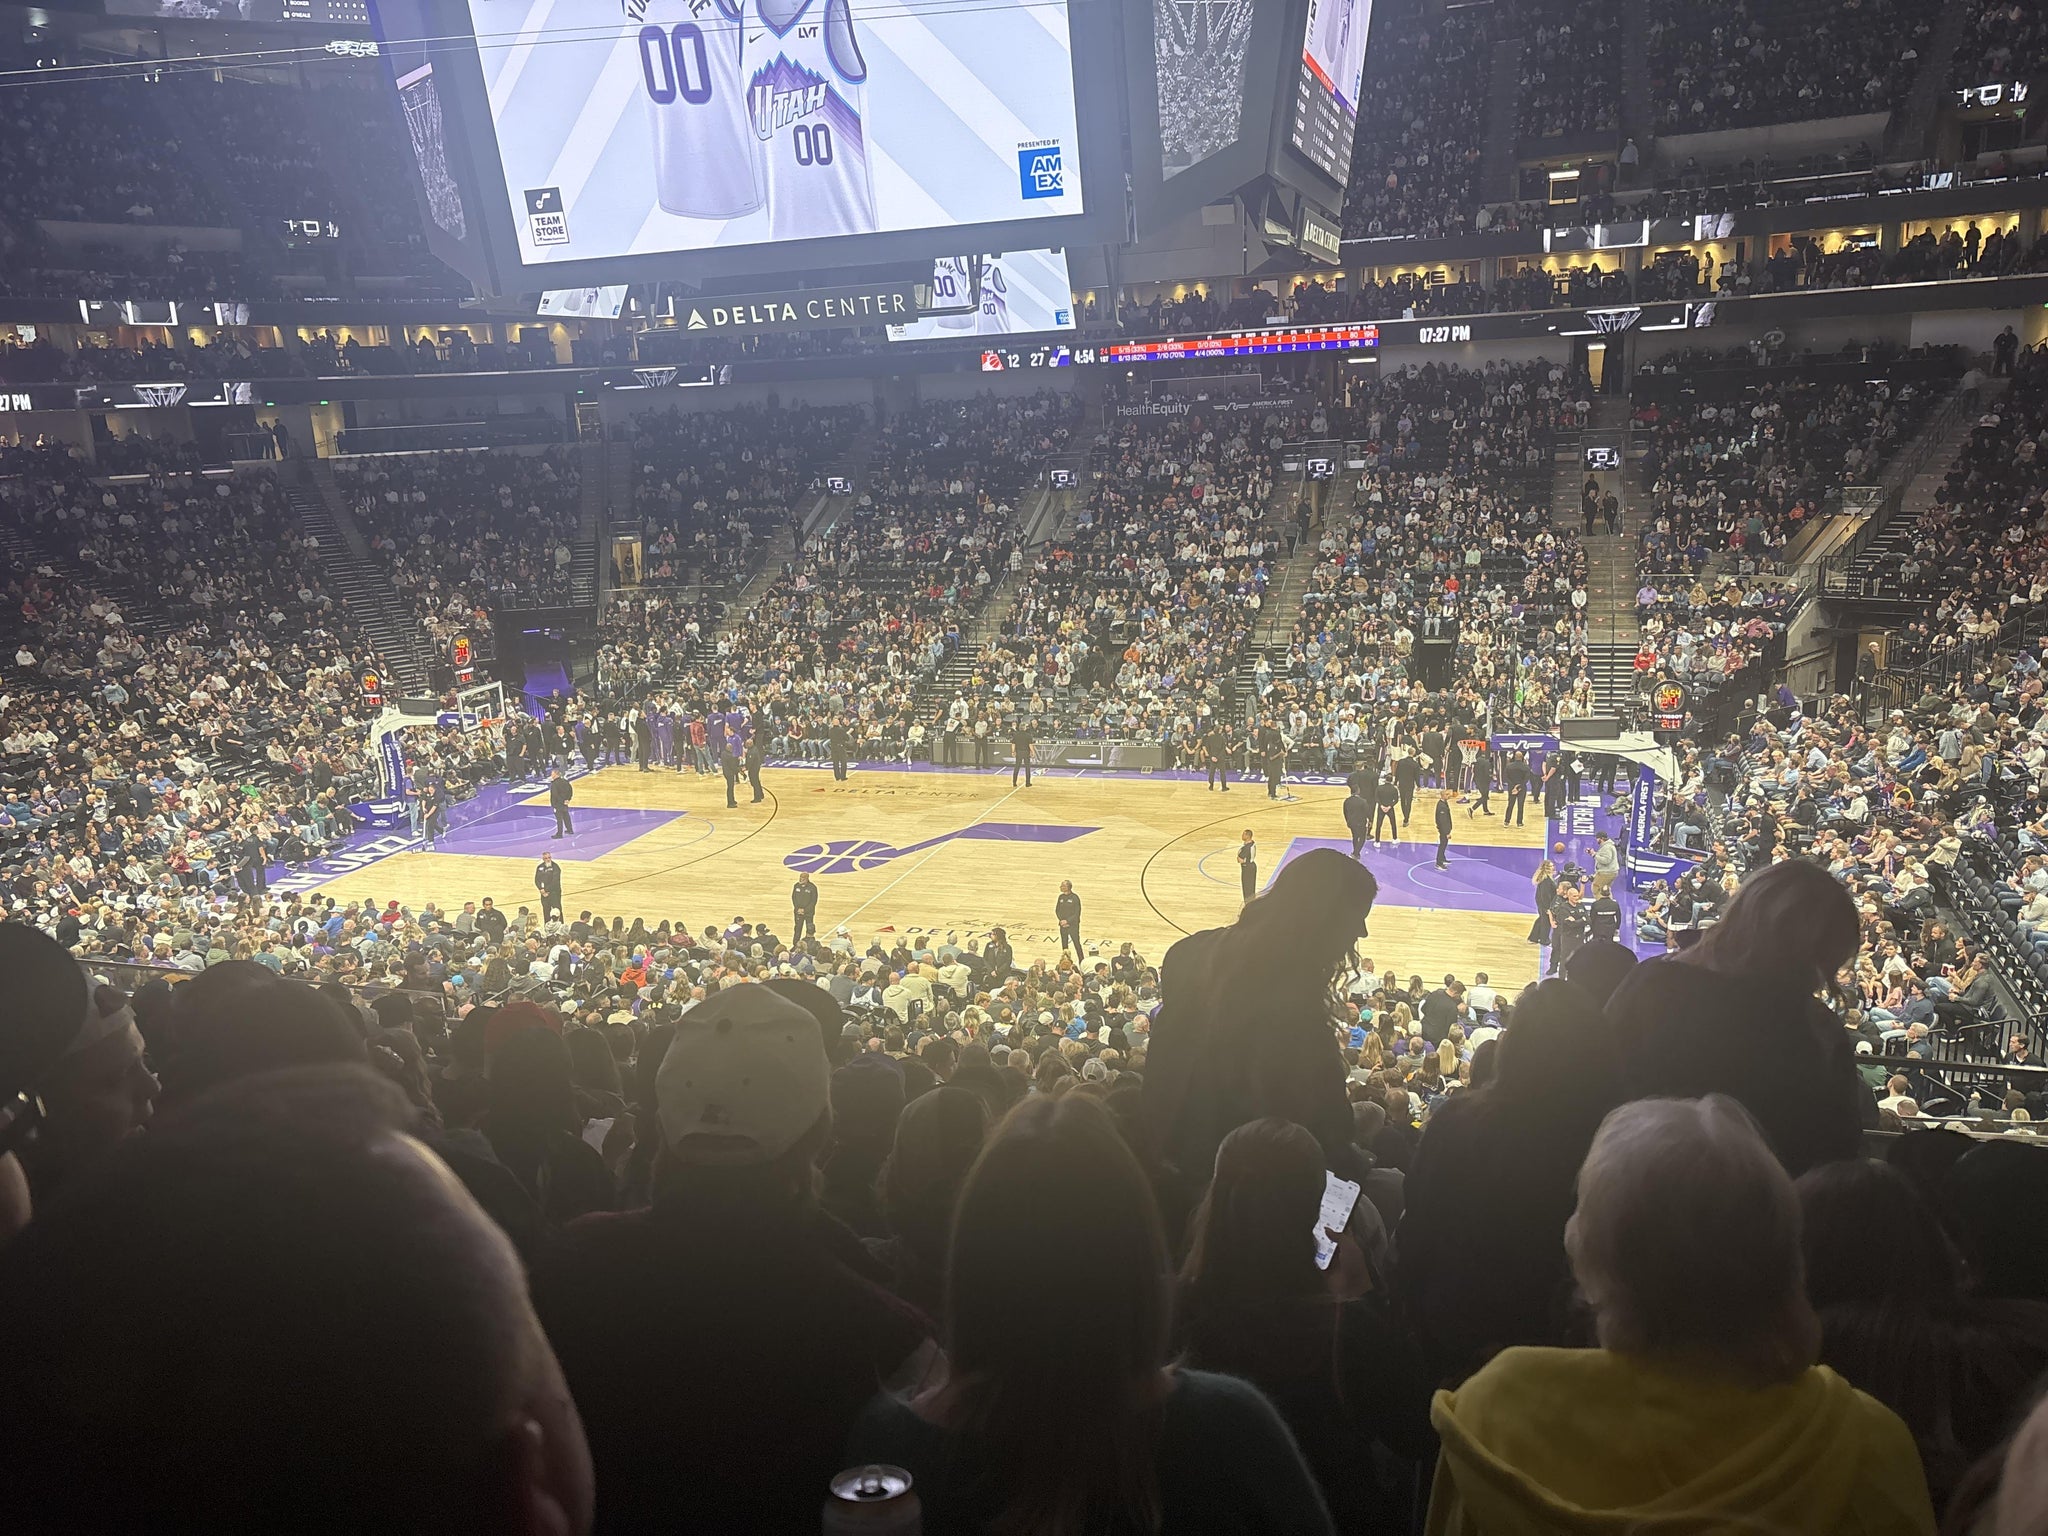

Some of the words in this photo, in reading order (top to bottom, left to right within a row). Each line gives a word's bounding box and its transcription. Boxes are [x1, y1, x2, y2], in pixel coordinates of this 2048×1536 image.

[798, 26, 818, 39] LVT
[639, 23, 712, 105] 00
[753, 81, 829, 141] UTAH
[793, 123, 833, 166] 00
[1017, 139, 1051, 149] PRESENTED
[1052, 138, 1060, 146] BY
[1032, 157, 1062, 173] AM
[535, 215, 561, 227] TEAM
[535, 225, 565, 237] STORE
[712, 302, 798, 326] DELTA
[807, 293, 906, 319] CENTER
[983, 303, 996, 315] 00
[1419, 326, 1450, 343] 07:27
[1452, 325, 1470, 342] PM
[1007, 354, 1020, 368] 12
[1030, 352, 1045, 367] 27
[1074, 348, 1095, 364] 4:54
[11, 393, 32, 411] PM
[1117, 403, 1190, 417] HealthEquity
[1639, 780, 1650, 805] FIRST
[1572, 807, 1595, 835] HEALTH
[1637, 804, 1647, 843] AMERICA
[322, 835, 425, 872] JAZZ
[1008, 934, 1113, 947] CENER
